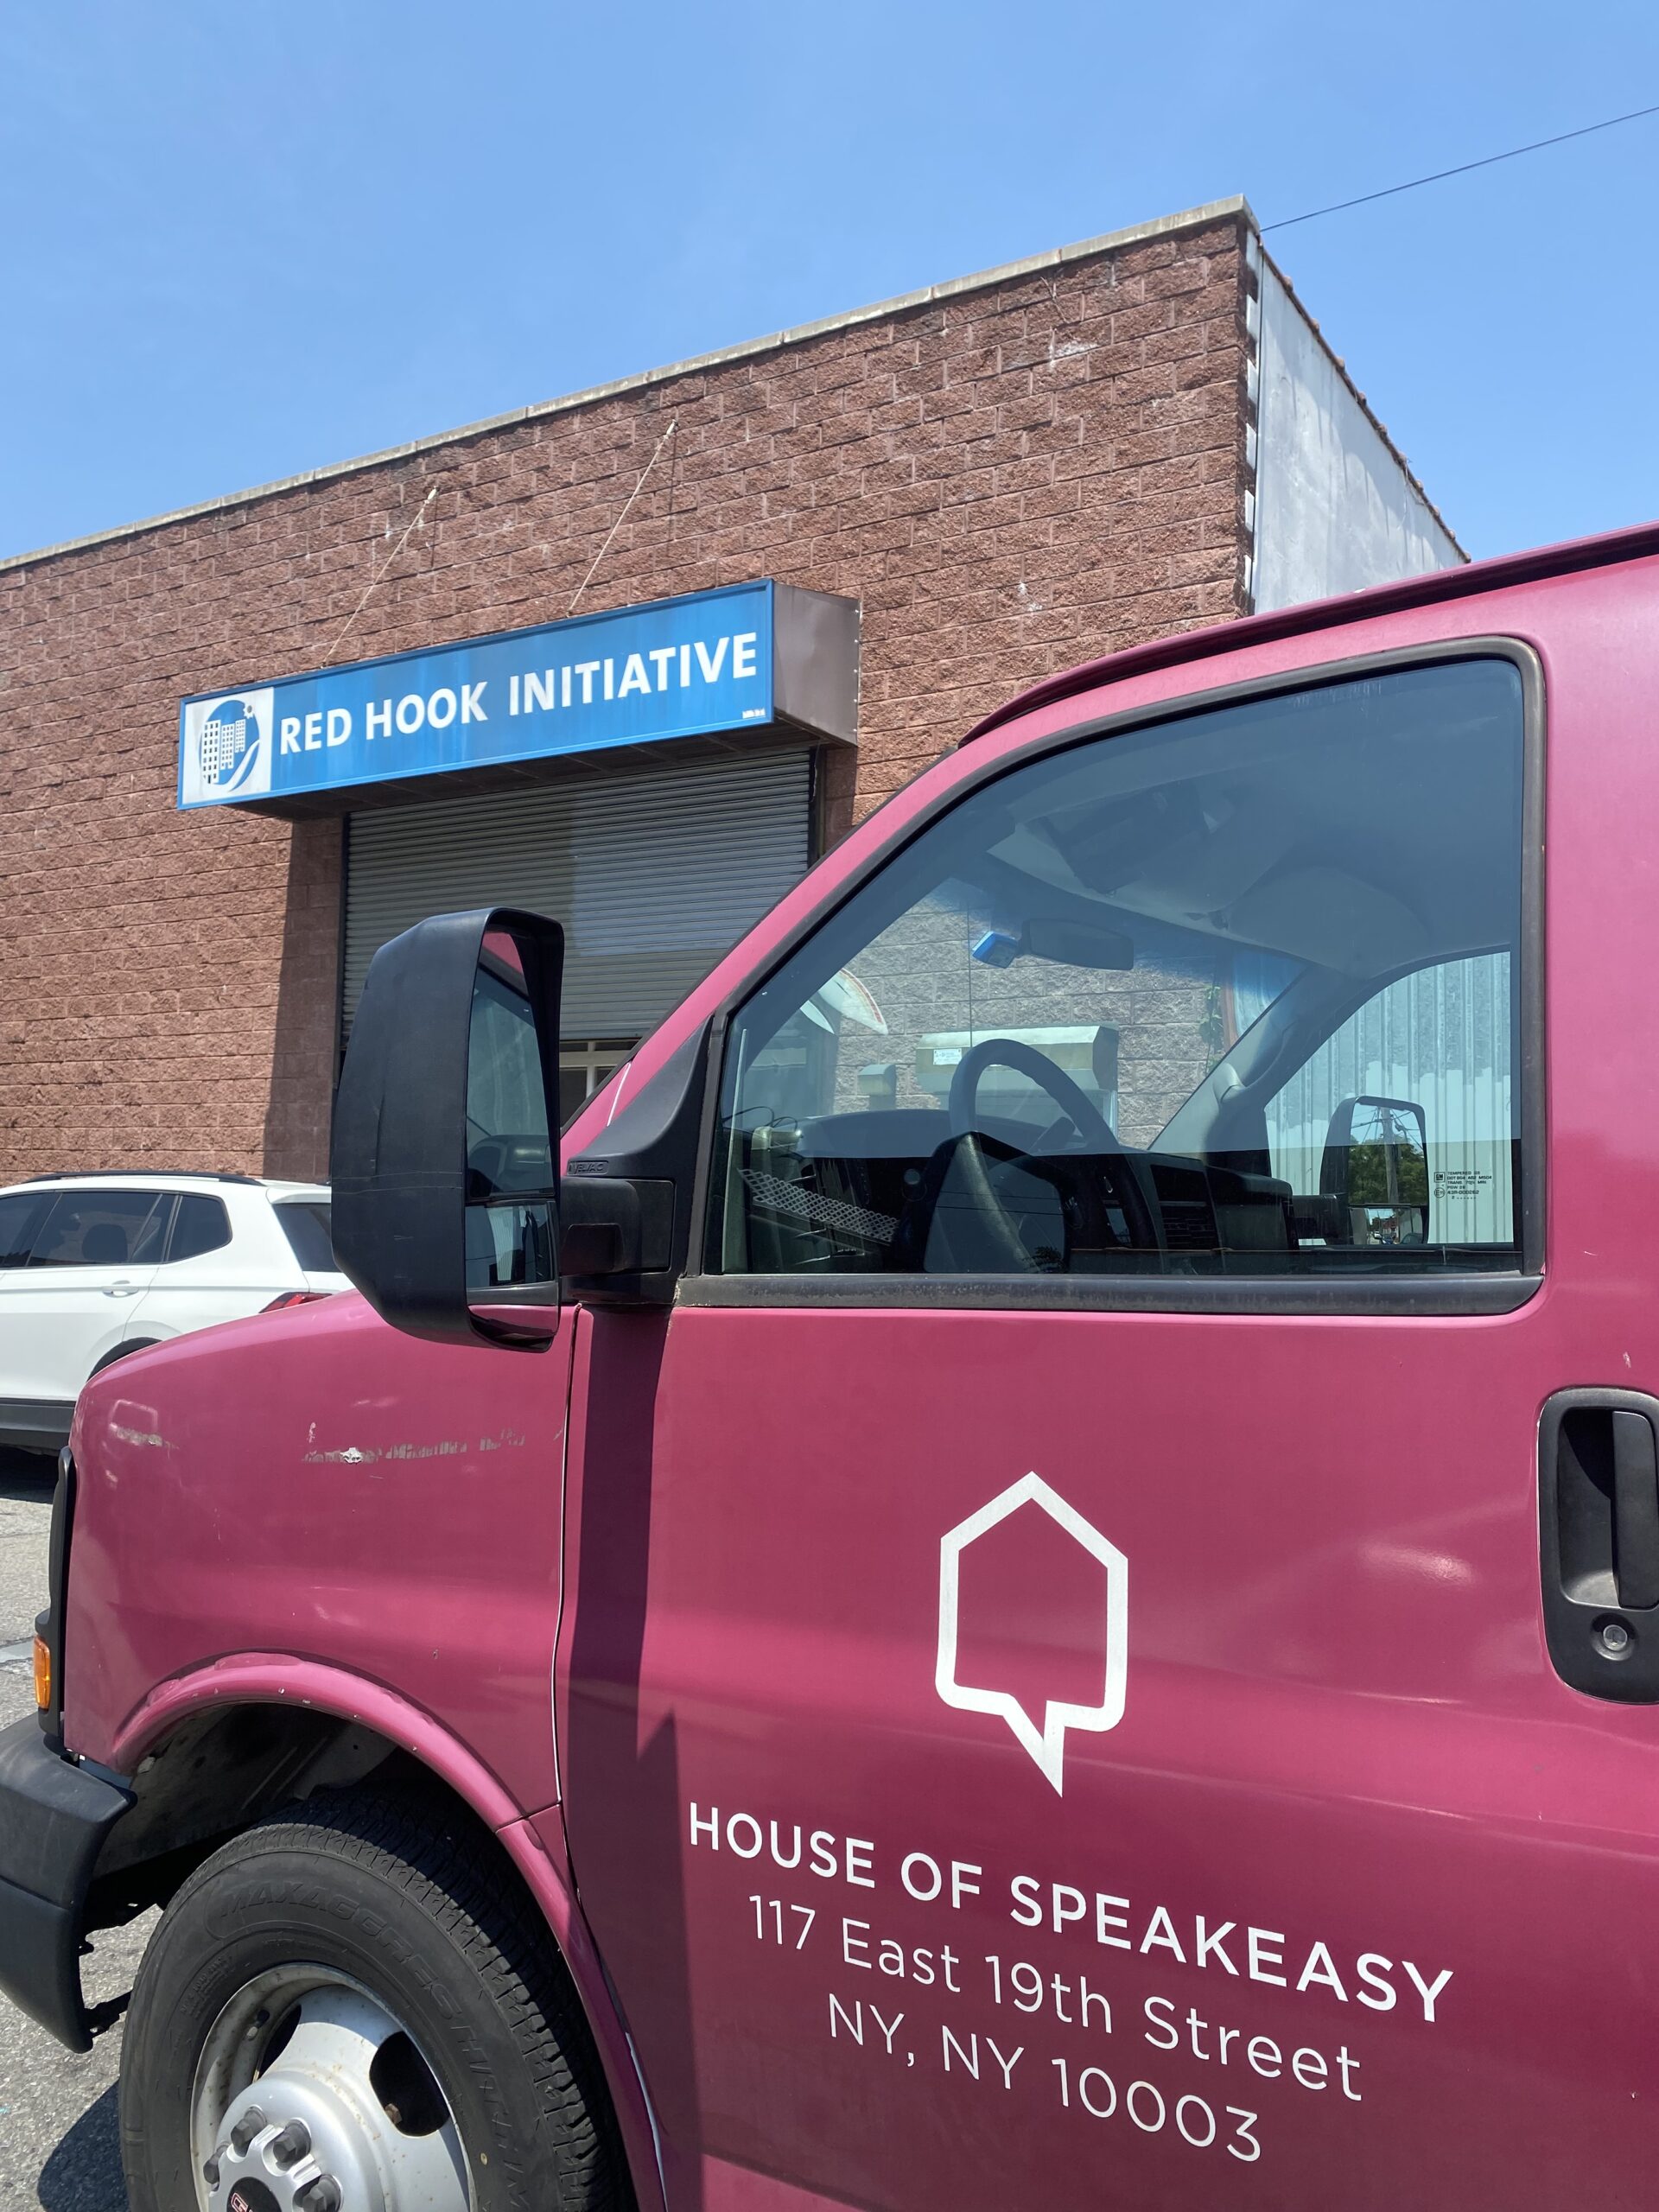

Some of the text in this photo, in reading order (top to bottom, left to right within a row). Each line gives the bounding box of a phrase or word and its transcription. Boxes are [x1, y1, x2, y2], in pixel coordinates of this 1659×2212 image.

[280, 632, 758, 755] RED HOOK INITIATIVE
[690, 1802, 1454, 2023] HOUSE OF SPEAKEASY
[749, 1895, 1362, 2101] 117 East 19th Street
[829, 1993, 1261, 2162] NY, NY 10003
